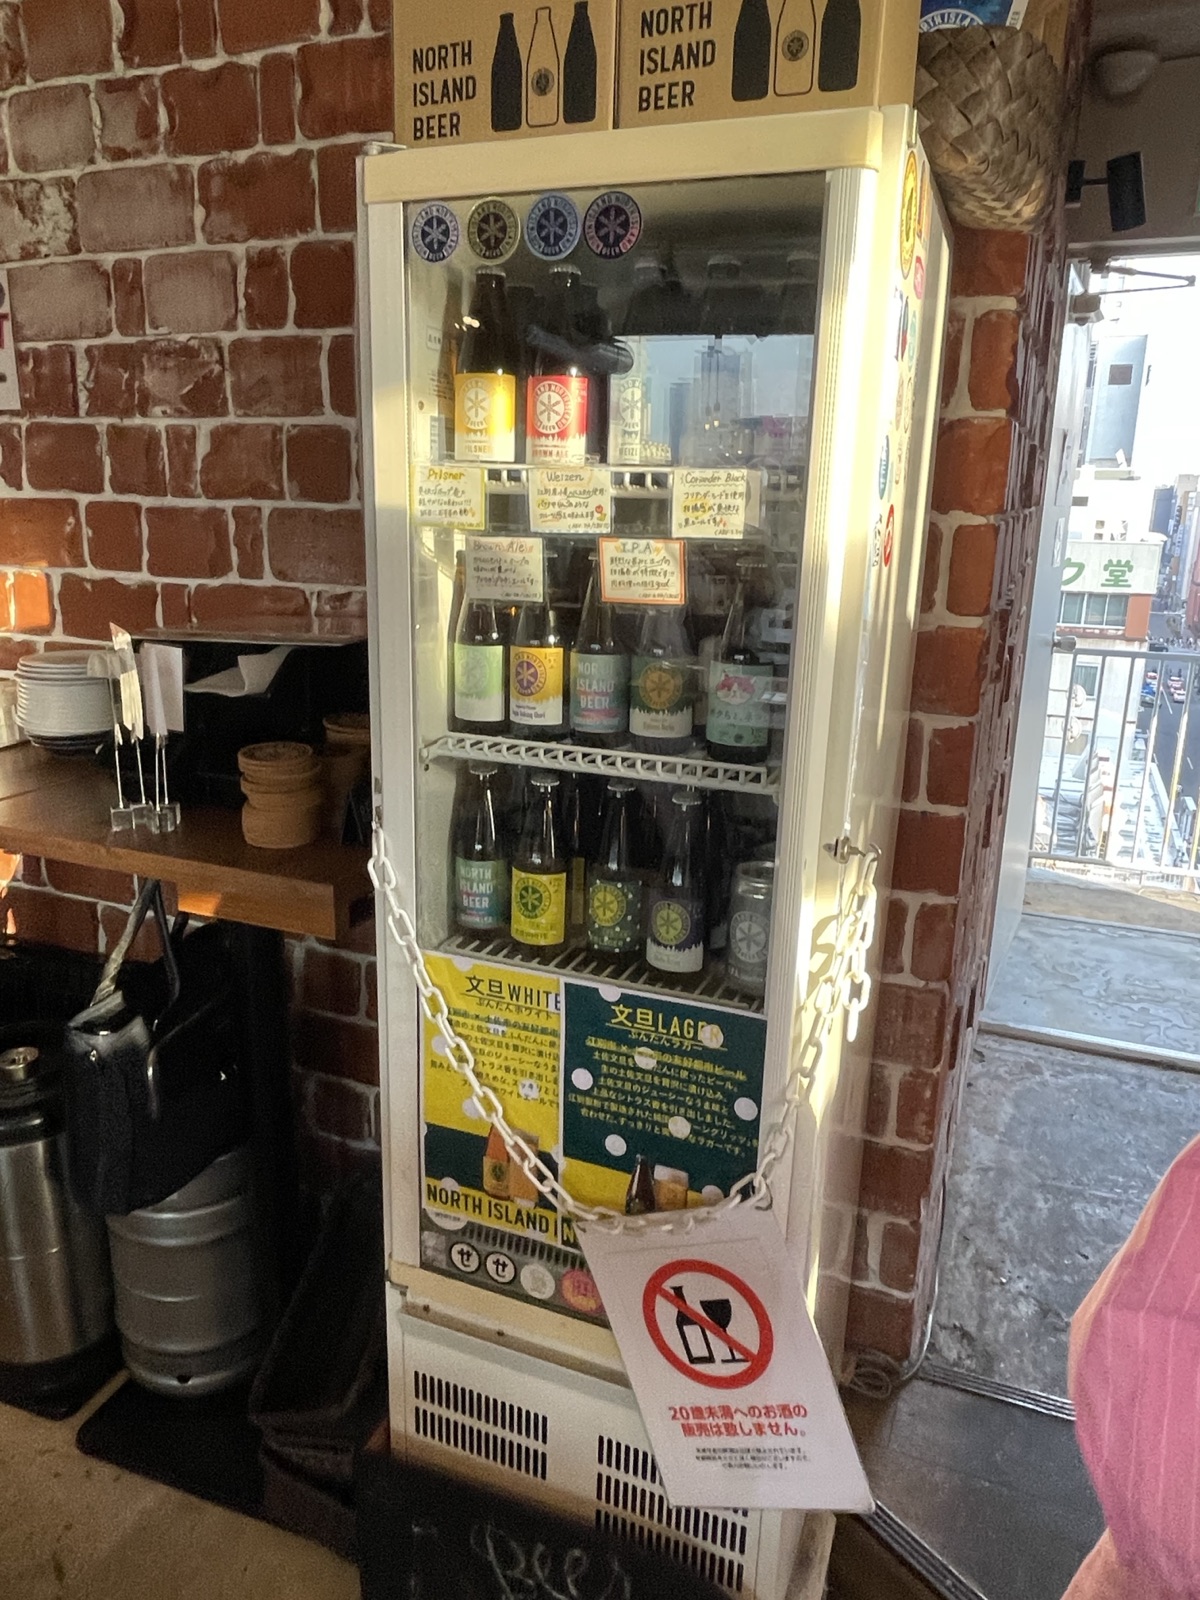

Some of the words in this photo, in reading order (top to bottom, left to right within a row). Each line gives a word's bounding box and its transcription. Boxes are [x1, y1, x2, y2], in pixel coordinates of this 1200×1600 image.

[640, 2, 713, 39] NORTH
[944, 12, 978, 28] ISLA
[412, 39, 473, 75] NORTH
[640, 39, 716, 77] ISLAND
[412, 76, 477, 108] ISLAND
[638, 80, 696, 113] BEER
[413, 112, 461, 142] BEER
[427, 467, 466, 481] Pilsner
[546, 470, 585, 482] Weizen
[685, 471, 722, 484] Coriander
[725, 472, 746, 483] Black
[507, 540, 526, 553] Ale
[576, 678, 615, 693] ISLAND
[580, 695, 610, 709] BEER
[460, 866, 492, 880] NORTH
[462, 894, 489, 908] BEER
[465, 975, 561, 1011] 文旦WHITE
[426, 1183, 482, 1216] NORTH
[488, 1204, 549, 1234] ISLAND
[668, 1404, 808, 1421] 20歳未満へのお酒の
[680, 1421, 806, 1438] 販売は致しません。
